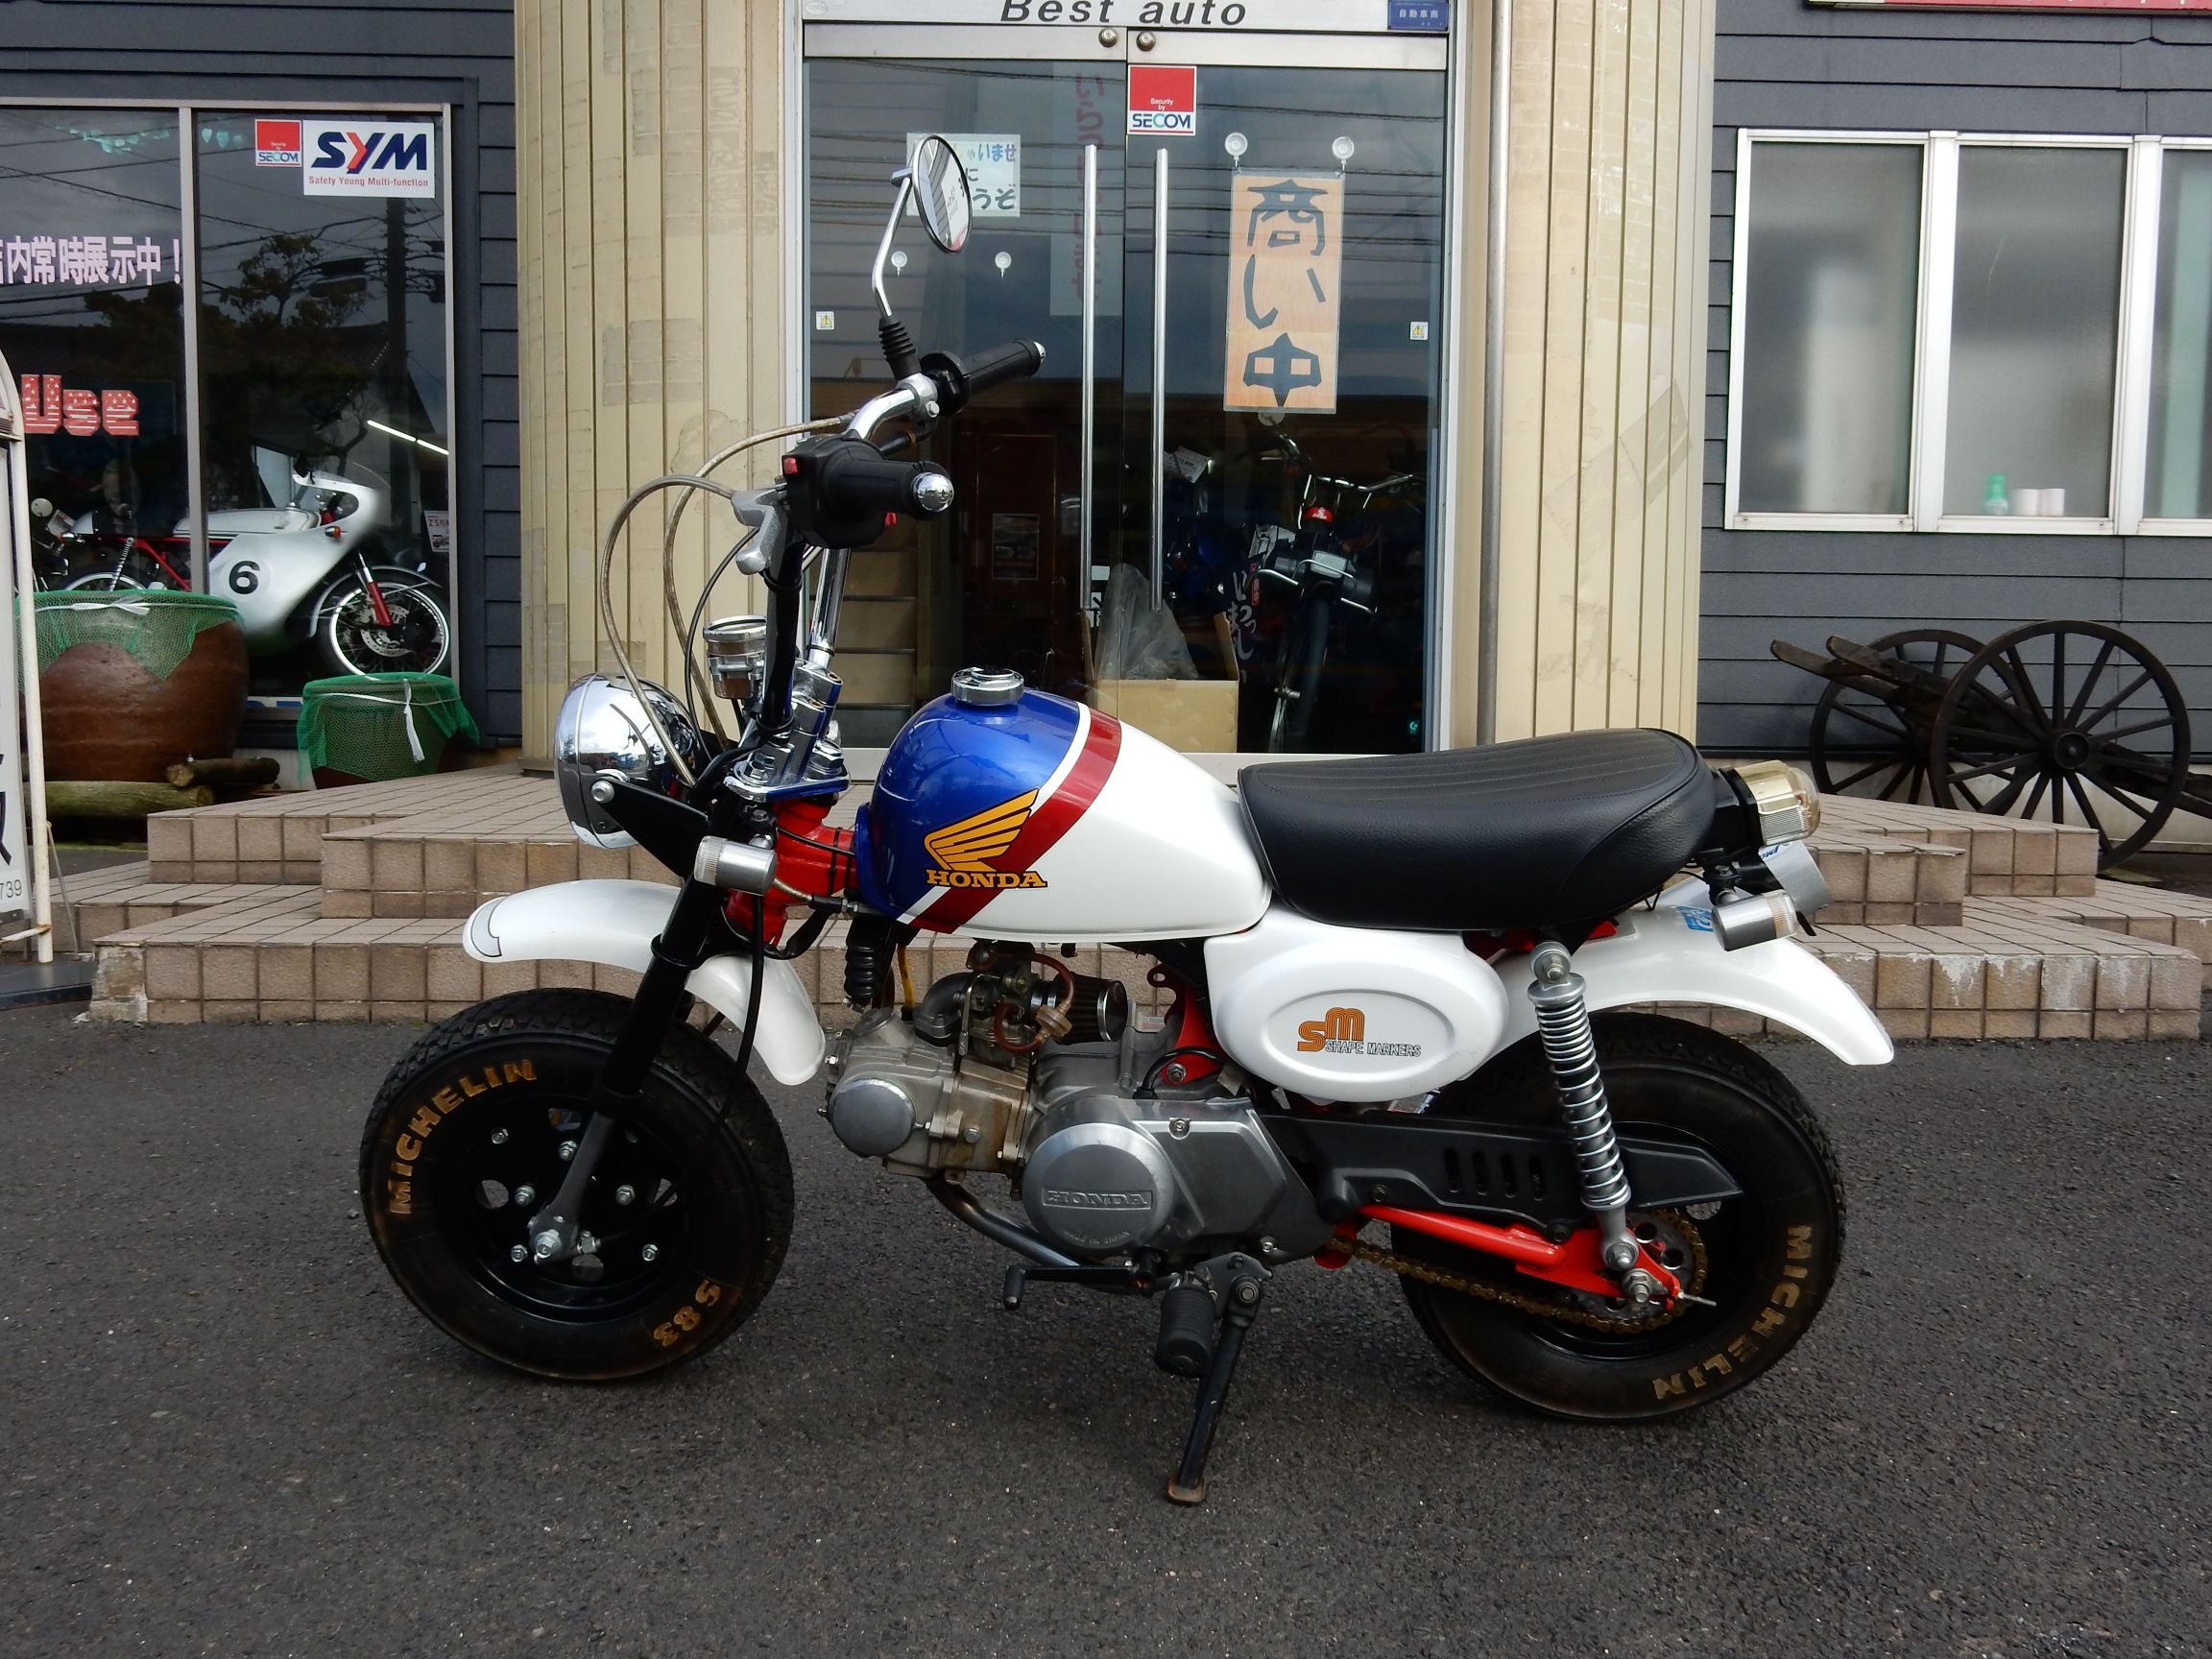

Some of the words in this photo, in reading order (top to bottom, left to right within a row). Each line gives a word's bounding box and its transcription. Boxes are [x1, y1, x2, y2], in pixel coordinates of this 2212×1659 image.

[1000, 0, 1115, 23] Best
[1139, 0, 1247, 26] auto
[1150, 98, 1173, 107] Security
[1132, 113, 1191, 129] SECOM
[258, 151, 300, 162] SECOM
[310, 131, 428, 175] SYM
[308, 176, 336, 186] Safety
[339, 177, 365, 187] Young
[368, 178, 429, 187] Multi-function
[1242, 179, 1329, 408] 商い中
[21, 373, 140, 437] Use
[228, 561, 260, 594] 6
[925, 868, 1048, 888] HONDA
[1325, 1040, 1364, 1055] SHAPE
[1367, 1042, 1422, 1057] MARKERS
[388, 1059, 537, 1214] MICHELIN
[1047, 1190, 1148, 1206] HONDA
[1652, 1225, 1813, 1400] MICHELIN
